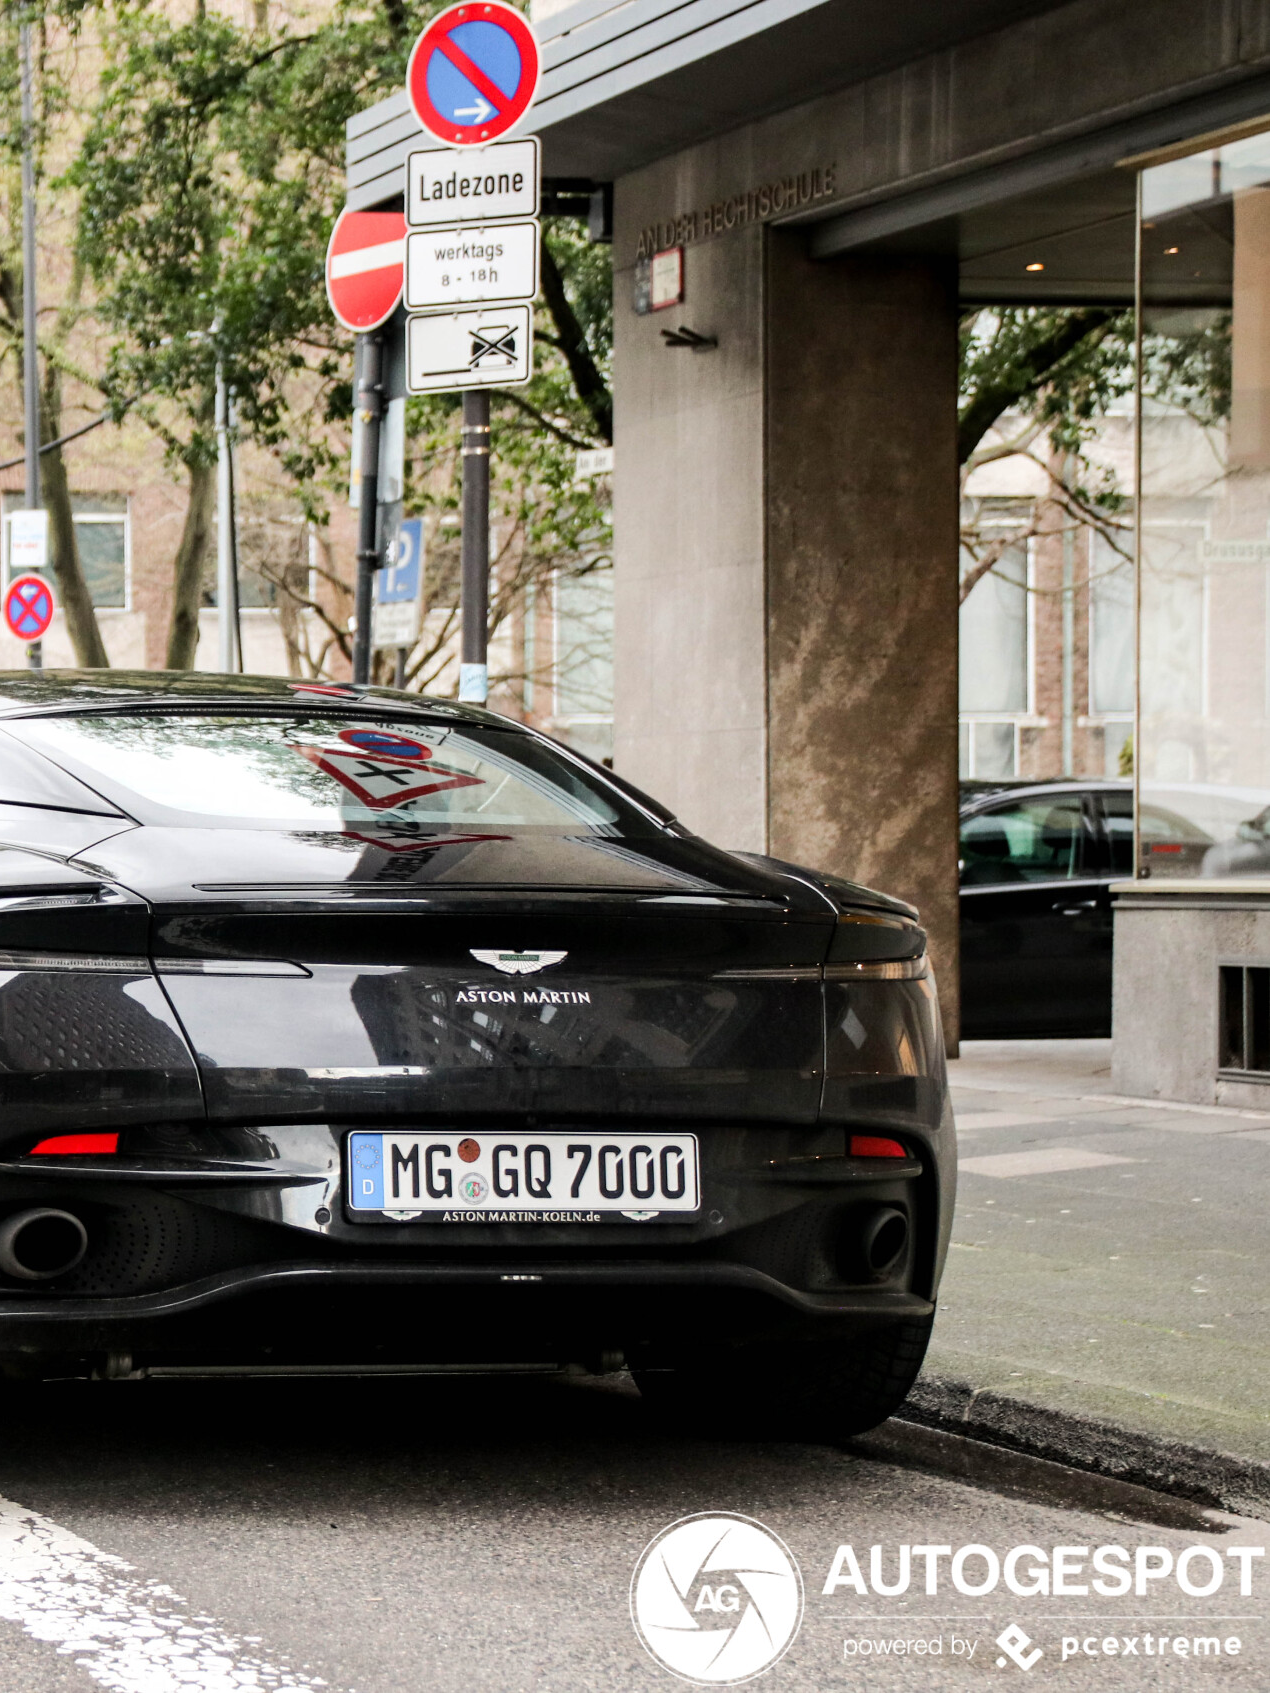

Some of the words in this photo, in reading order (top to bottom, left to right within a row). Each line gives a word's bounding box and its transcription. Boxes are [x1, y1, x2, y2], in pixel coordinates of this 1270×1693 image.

[419, 170, 524, 203] Ladezone
[636, 223, 660, 258] AN
[703, 166, 836, 238] HECHTSCHULE
[434, 242, 504, 263] werktags
[441, 273, 451, 287] 8
[470, 268, 498, 284] 18h
[456, 990, 517, 1004] ASTON
[523, 990, 592, 1004] MARTIN
[390, 1143, 453, 1200] MG
[491, 1144, 553, 1200] GQ
[566, 1144, 686, 1201] 7000
[362, 1178, 375, 1195] D
[442, 1211, 487, 1222] ASTON
[488, 1211, 601, 1223] MARTIN-KOELN.de
